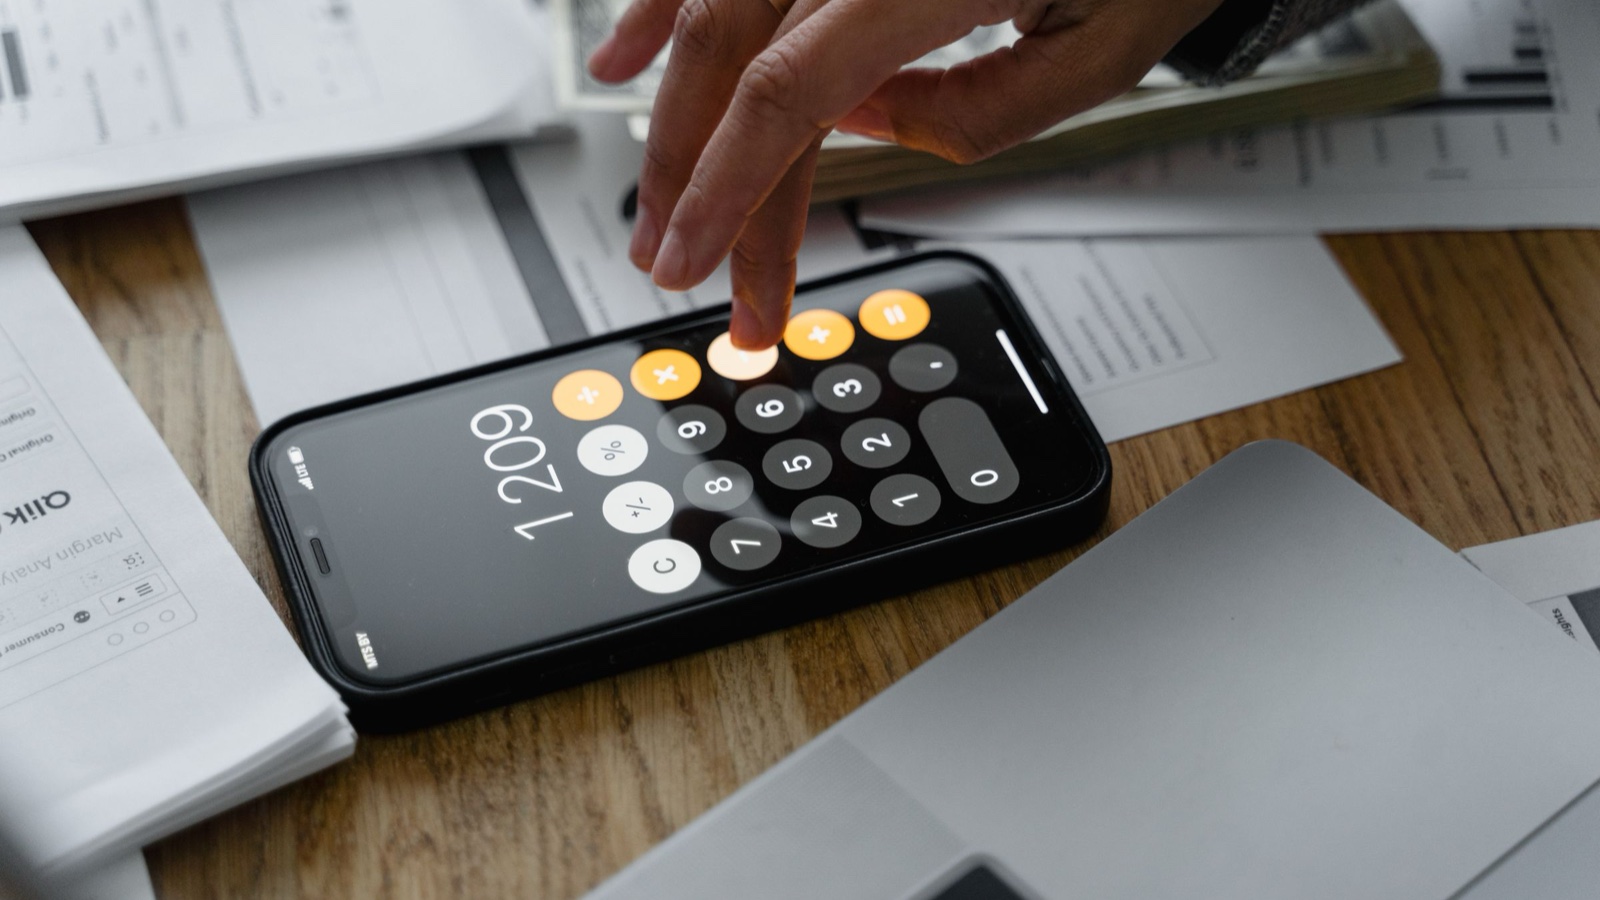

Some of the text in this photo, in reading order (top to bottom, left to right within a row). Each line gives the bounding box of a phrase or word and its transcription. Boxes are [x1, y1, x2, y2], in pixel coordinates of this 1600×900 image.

[832, 378, 862, 397] 3
[0, 407, 36, 427] Origin
[677, 420, 707, 439] 9
[8, 433, 54, 459] Original
[600, 440, 625, 461] %
[861, 432, 892, 452] 2
[295, 464, 309, 478] LTE
[755, 399, 838, 529] 4 5 6
[704, 476, 733, 495] 8
[970, 469, 999, 487] 0
[2, 490, 71, 526] Qlik
[892, 493, 919, 508] 1
[0, 526, 124, 586] Margin Analy
[730, 538, 761, 554] 7
[652, 557, 677, 575] C
[4, 622, 65, 654] Consumer
[355, 633, 379, 669] MTS BY
